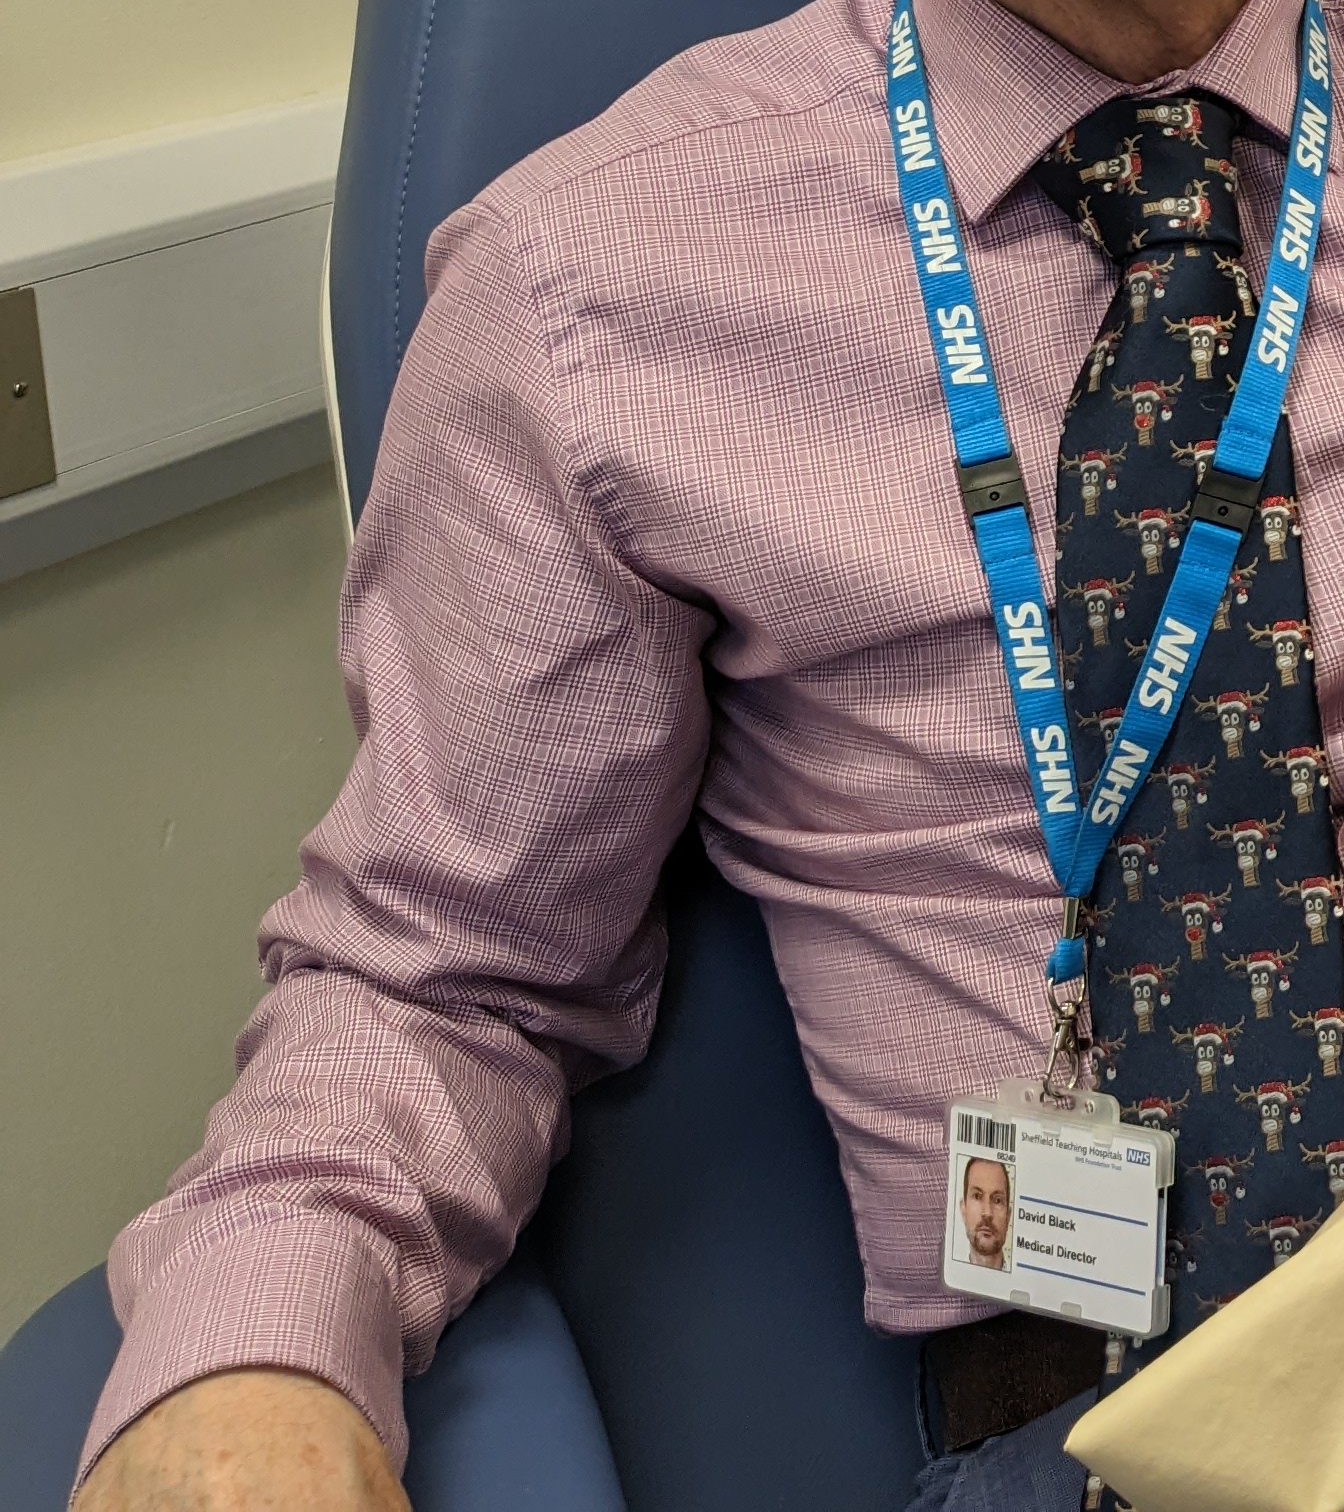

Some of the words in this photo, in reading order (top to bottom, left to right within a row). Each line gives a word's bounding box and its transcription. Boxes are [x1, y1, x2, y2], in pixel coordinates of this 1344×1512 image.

[893, 10, 917, 79] NHS
[1309, 17, 1329, 91] NHS
[896, 99, 936, 173] NHS
[1295, 99, 1329, 177] NHS
[915, 198, 962, 273] NHS
[1280, 188, 1316, 271] NHS
[938, 303, 988, 385] NHS
[1258, 284, 1298, 372] NHS
[1004, 601, 1056, 690] NHS
[1139, 616, 1198, 715] NHS
[1031, 724, 1077, 814] NHS
[1091, 739, 1149, 826] NHS
[1022, 1132, 1053, 1146] Sheffield
[1055, 1138, 1087, 1156] Teaching
[1089, 1146, 1122, 1161] Hospitals
[1128, 1150, 1150, 1164] NHS
[1016, 1236, 1054, 1256] Medical
[1057, 1245, 1097, 1266] Director
[1018, 1208, 1046, 1225] David
[1048, 1214, 1077, 1232] Black
